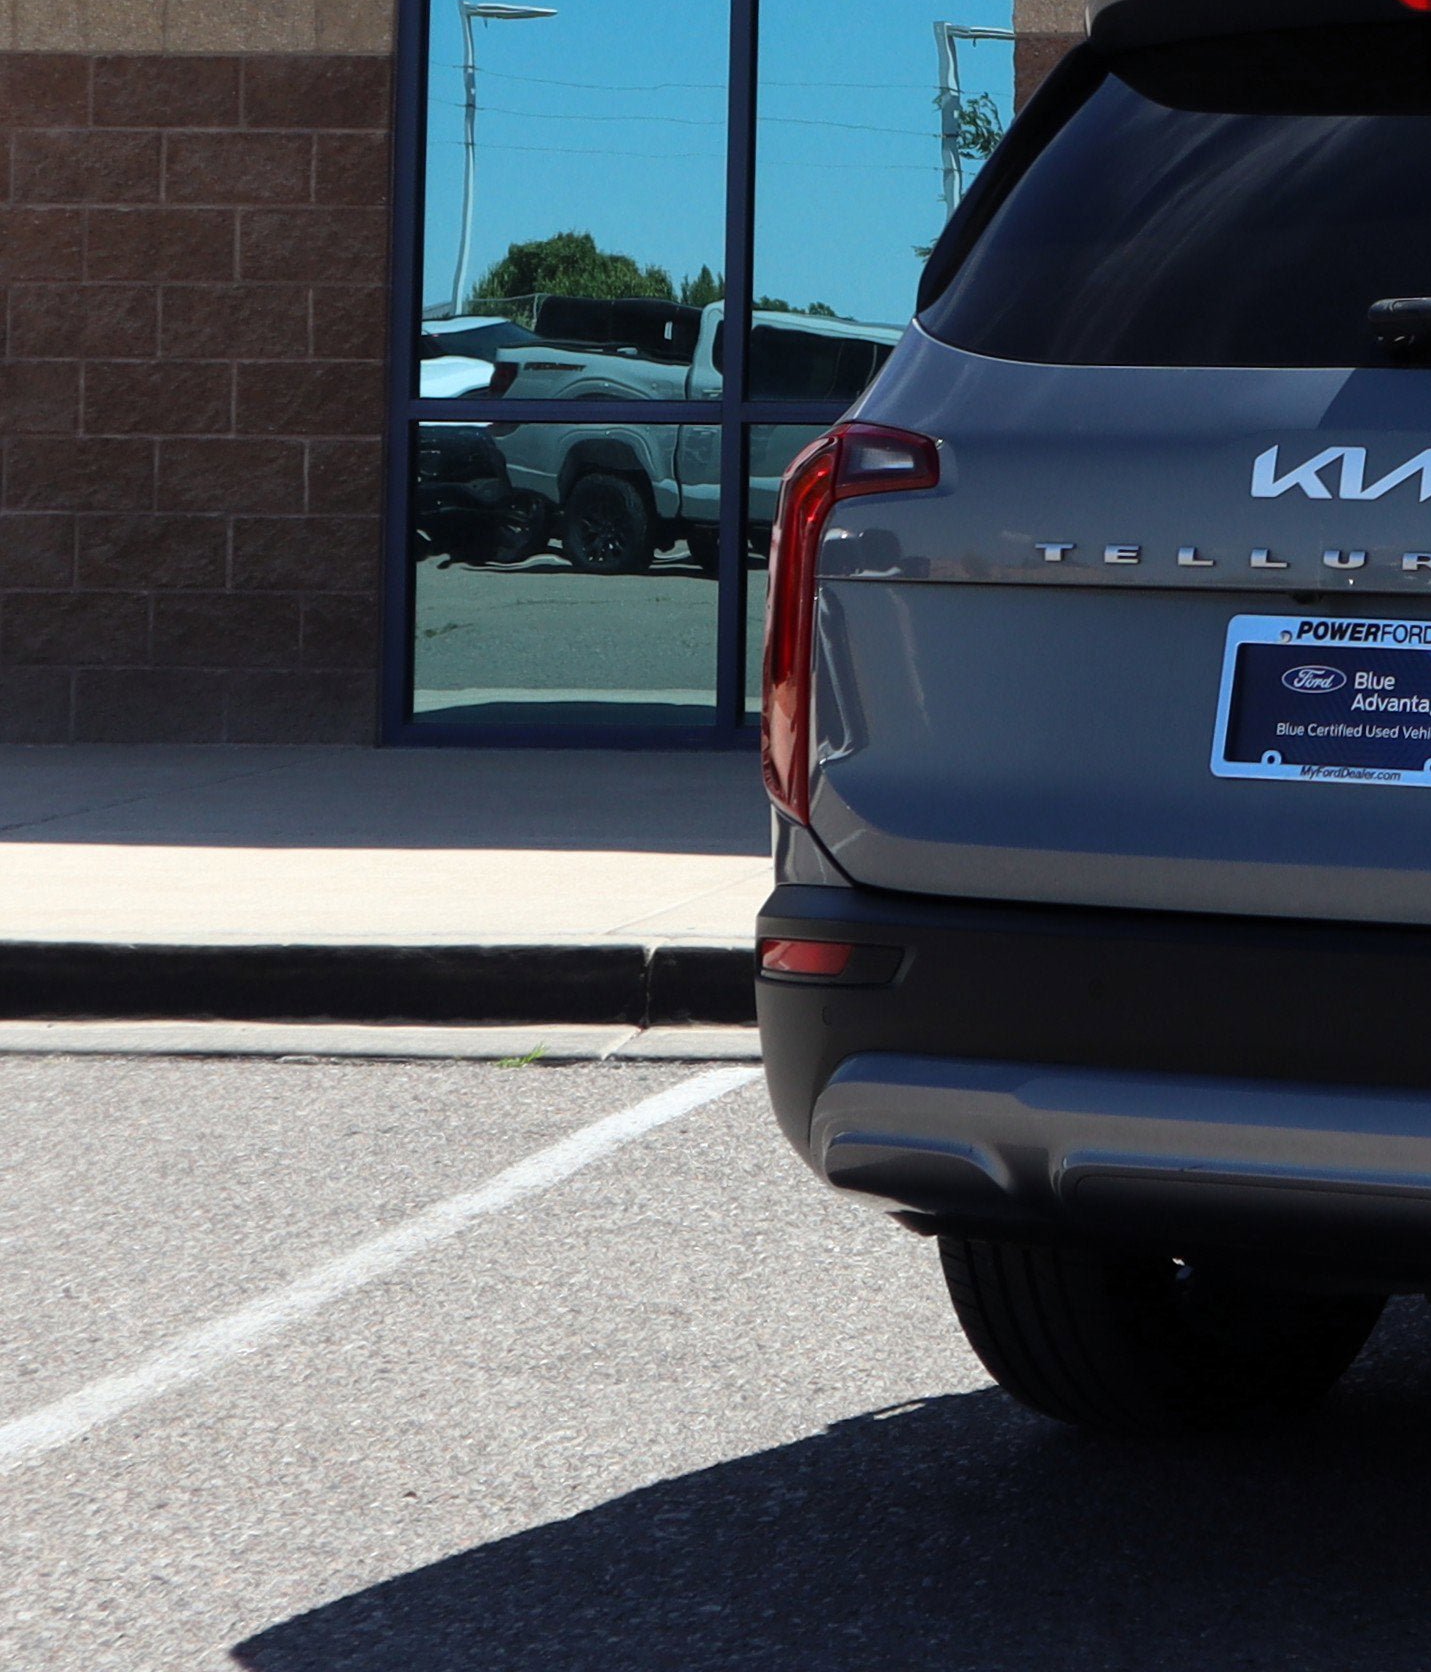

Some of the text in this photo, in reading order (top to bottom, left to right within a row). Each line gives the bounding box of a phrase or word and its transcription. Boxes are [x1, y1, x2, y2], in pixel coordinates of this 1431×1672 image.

[1293, 668, 1337, 690] Ford
[1353, 671, 1396, 691] Blue
[1276, 722, 1305, 736] Blue
[1307, 723, 1362, 738] Certified
[1365, 724, 1399, 739] Used
[1300, 766, 1402, 781] MyFordDealer.com
